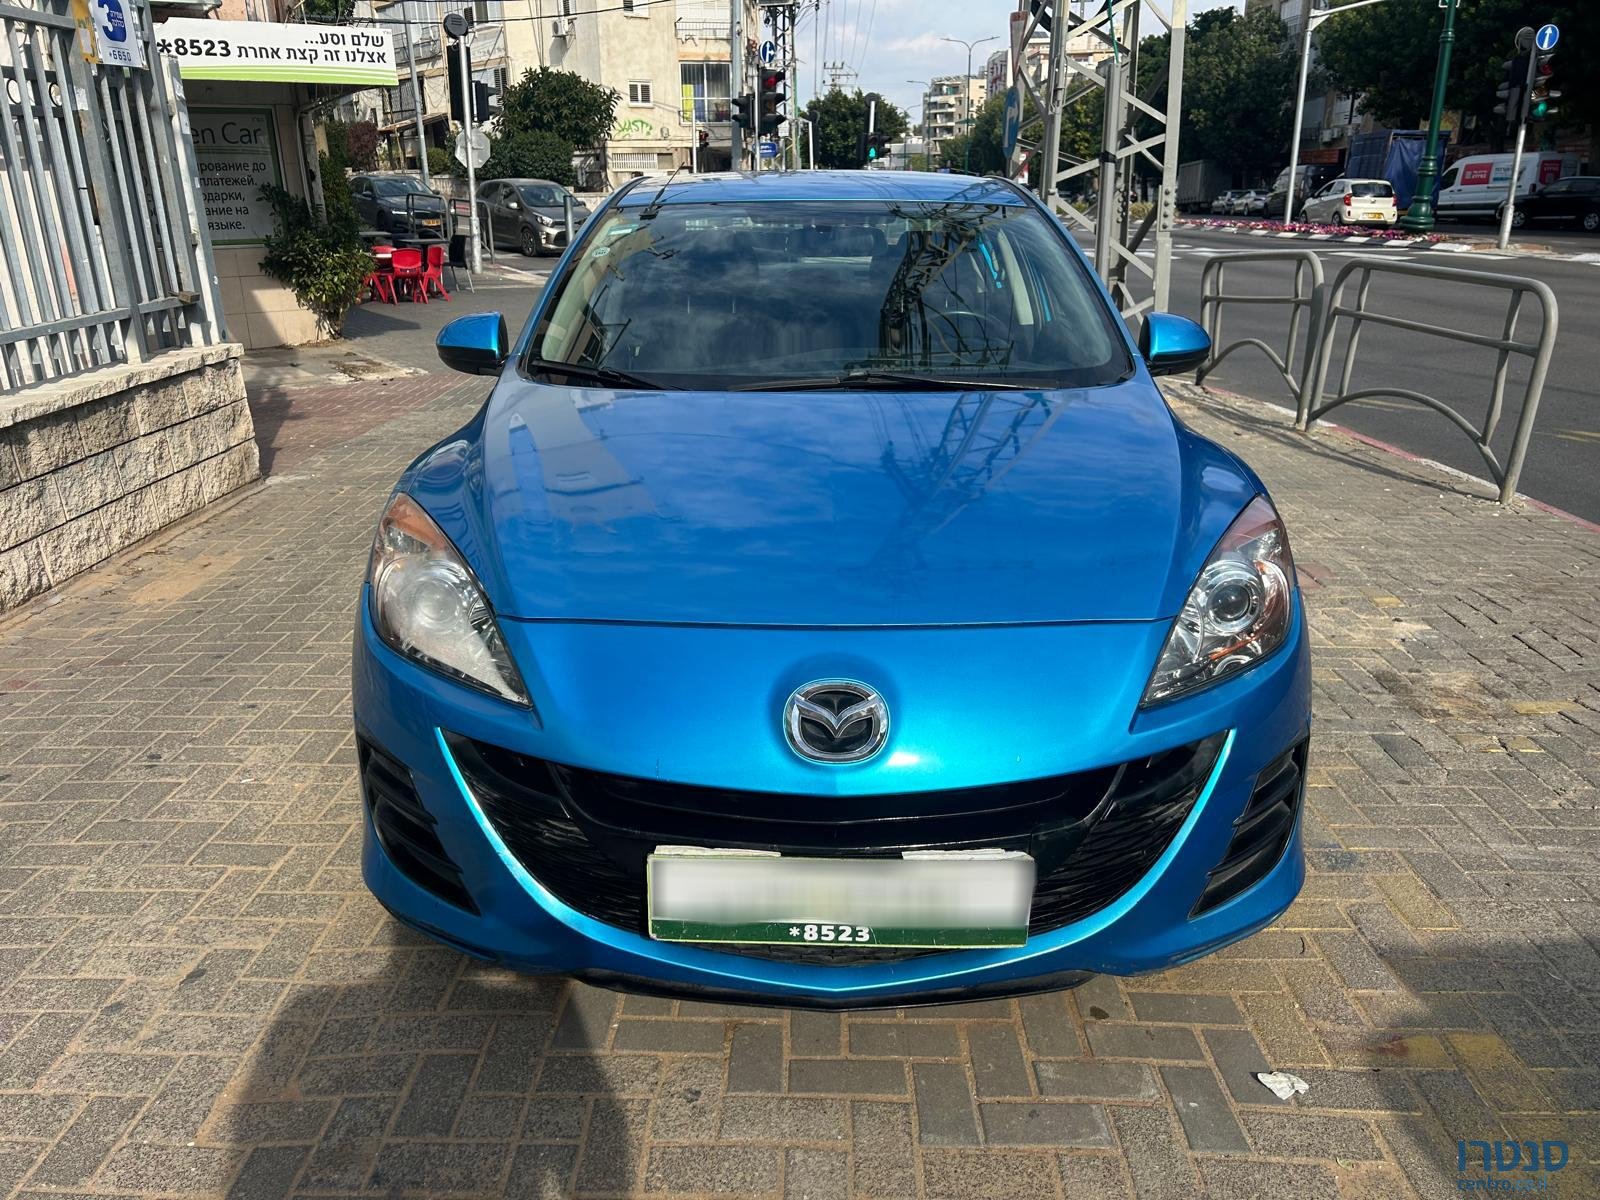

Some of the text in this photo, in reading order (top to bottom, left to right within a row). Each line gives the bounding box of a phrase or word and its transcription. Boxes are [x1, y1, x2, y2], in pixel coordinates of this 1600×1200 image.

[305, 32, 384, 47] שלם וסע...
[237, 46, 387, 64] אצלנו זה קצת אחרת
[191, 122, 262, 145] en Car
[197, 162, 267, 173] рование до
[202, 191, 245, 203] одарки,
[205, 206, 249, 216] ание на
[208, 220, 246, 231] языке.
